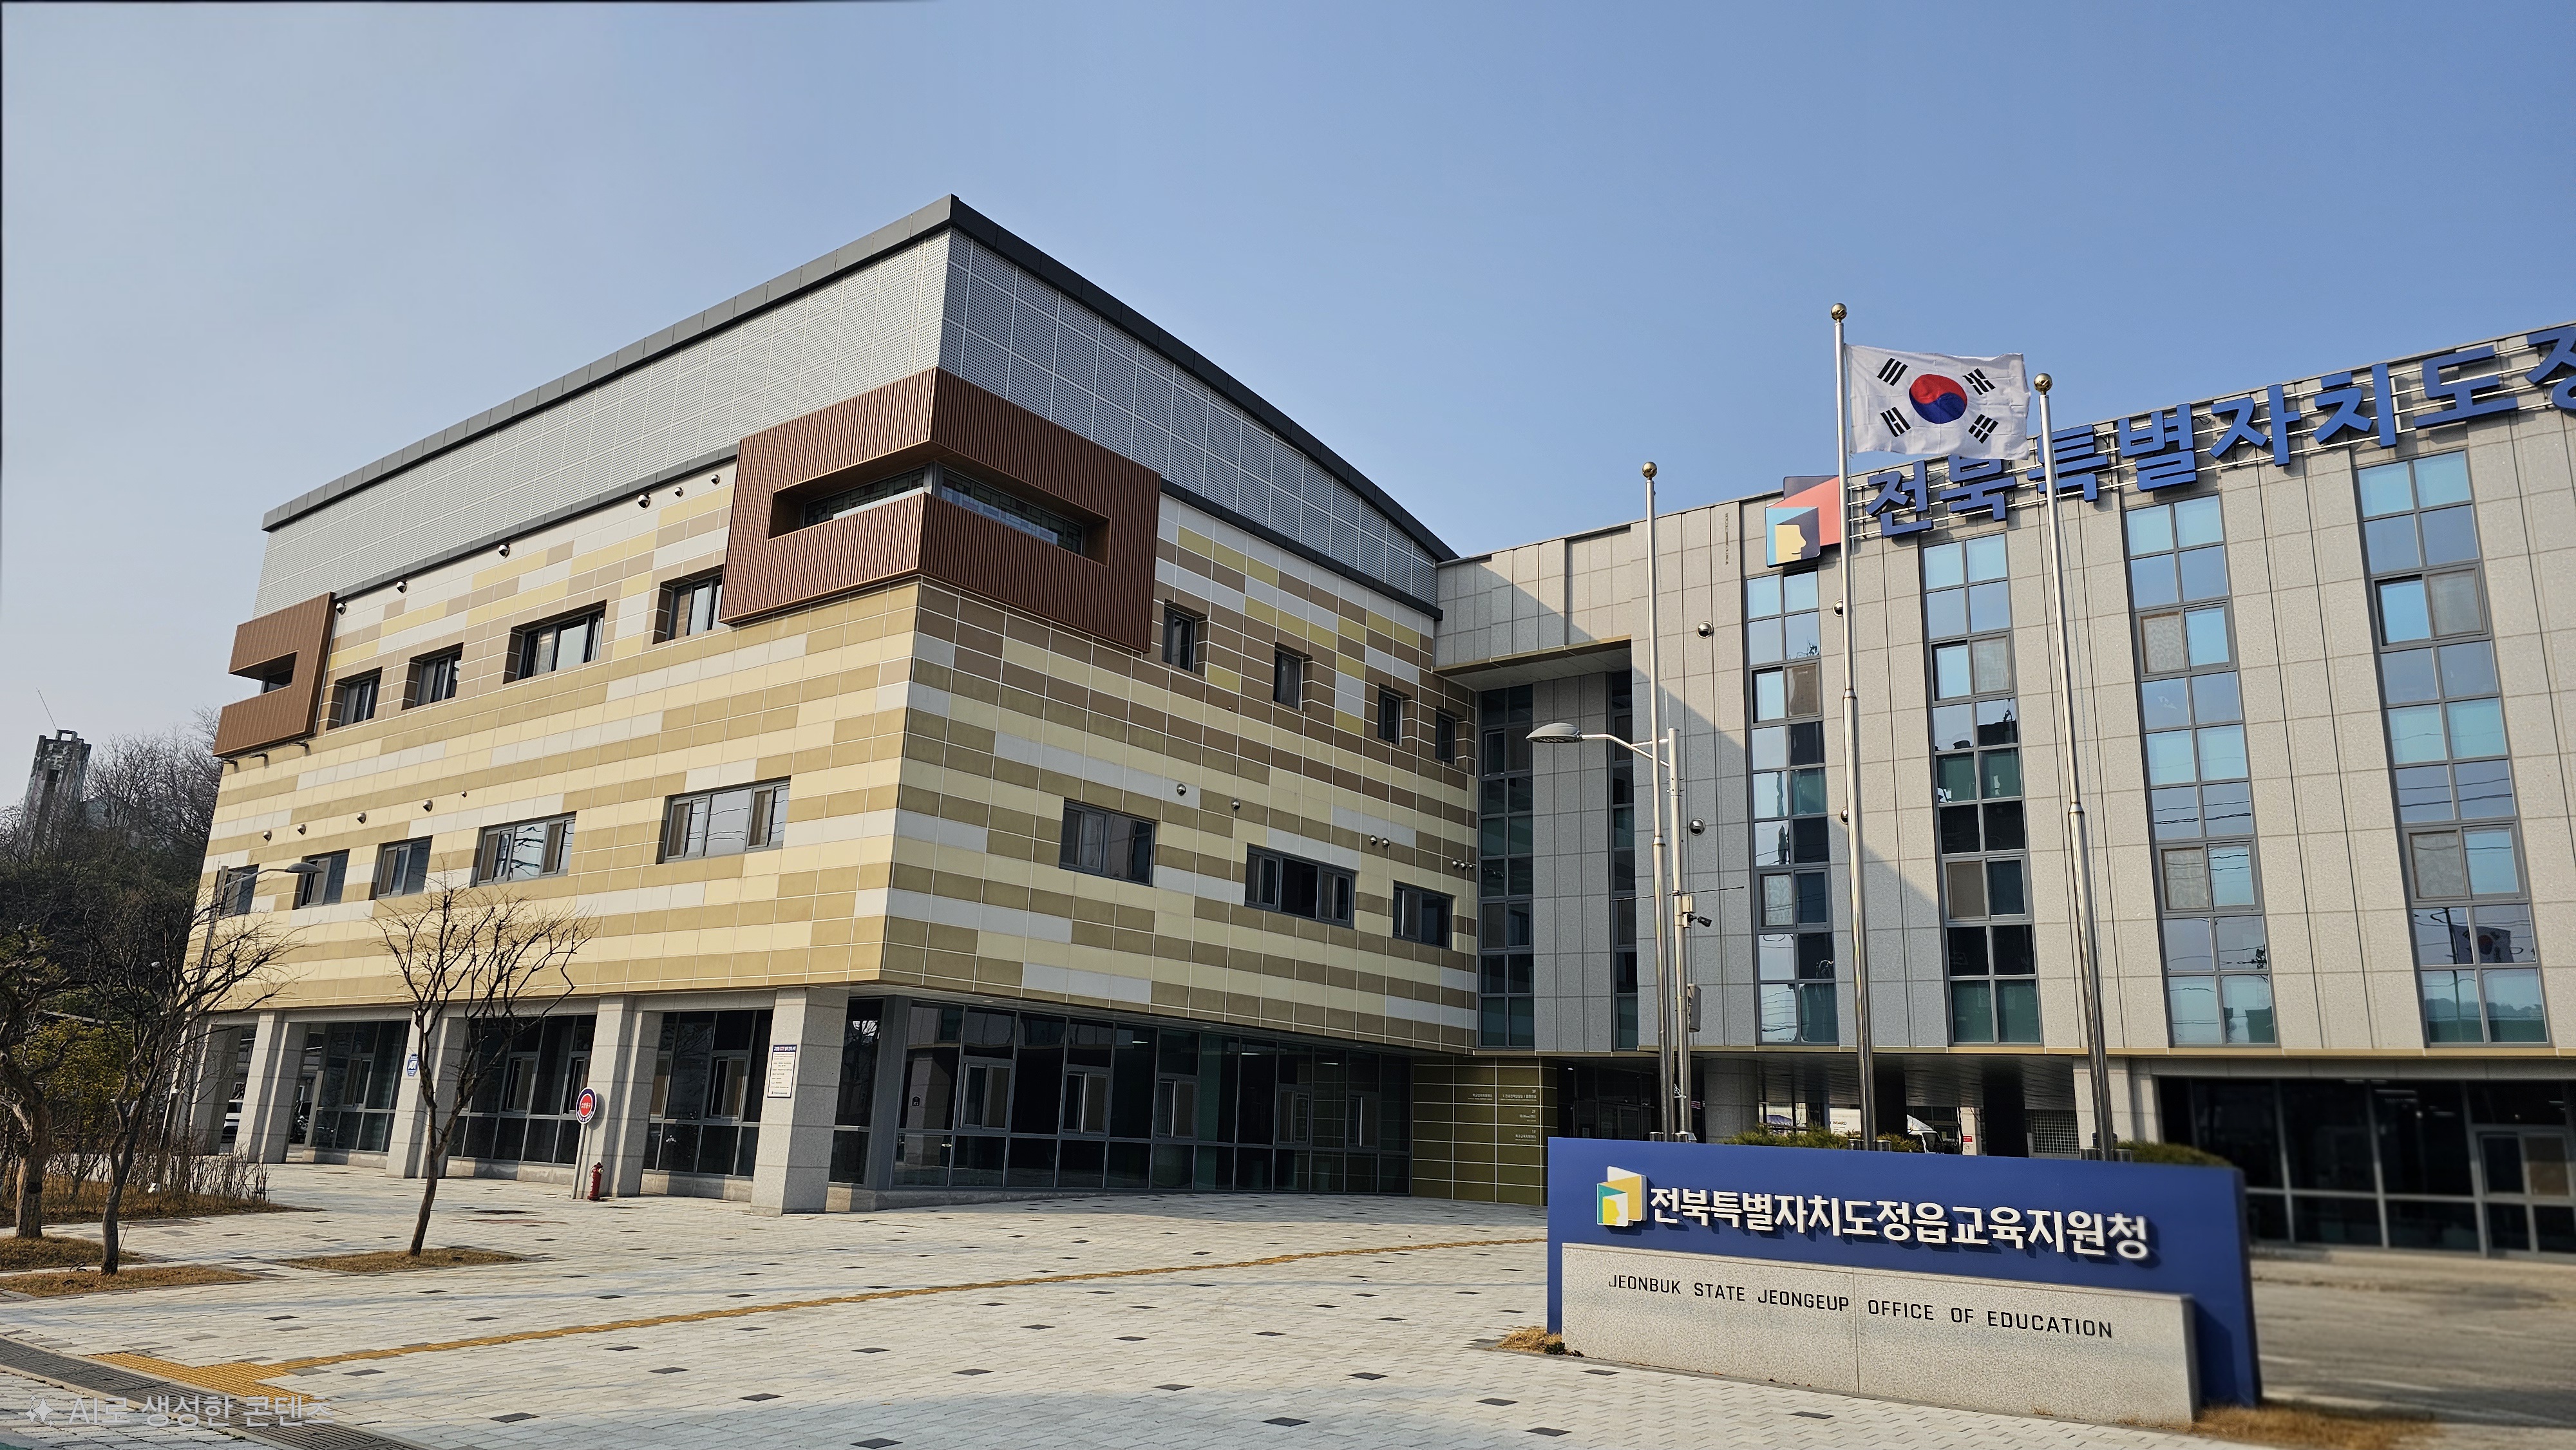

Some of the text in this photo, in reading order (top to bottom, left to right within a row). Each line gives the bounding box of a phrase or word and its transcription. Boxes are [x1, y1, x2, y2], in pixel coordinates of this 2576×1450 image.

[1651, 1187, 2148, 1260] 전북특별자치도정읍교육지원청
[1609, 1274, 2112, 1339] JEONBUK STATE JEONGEUP OFFICE OF EDUCATION
